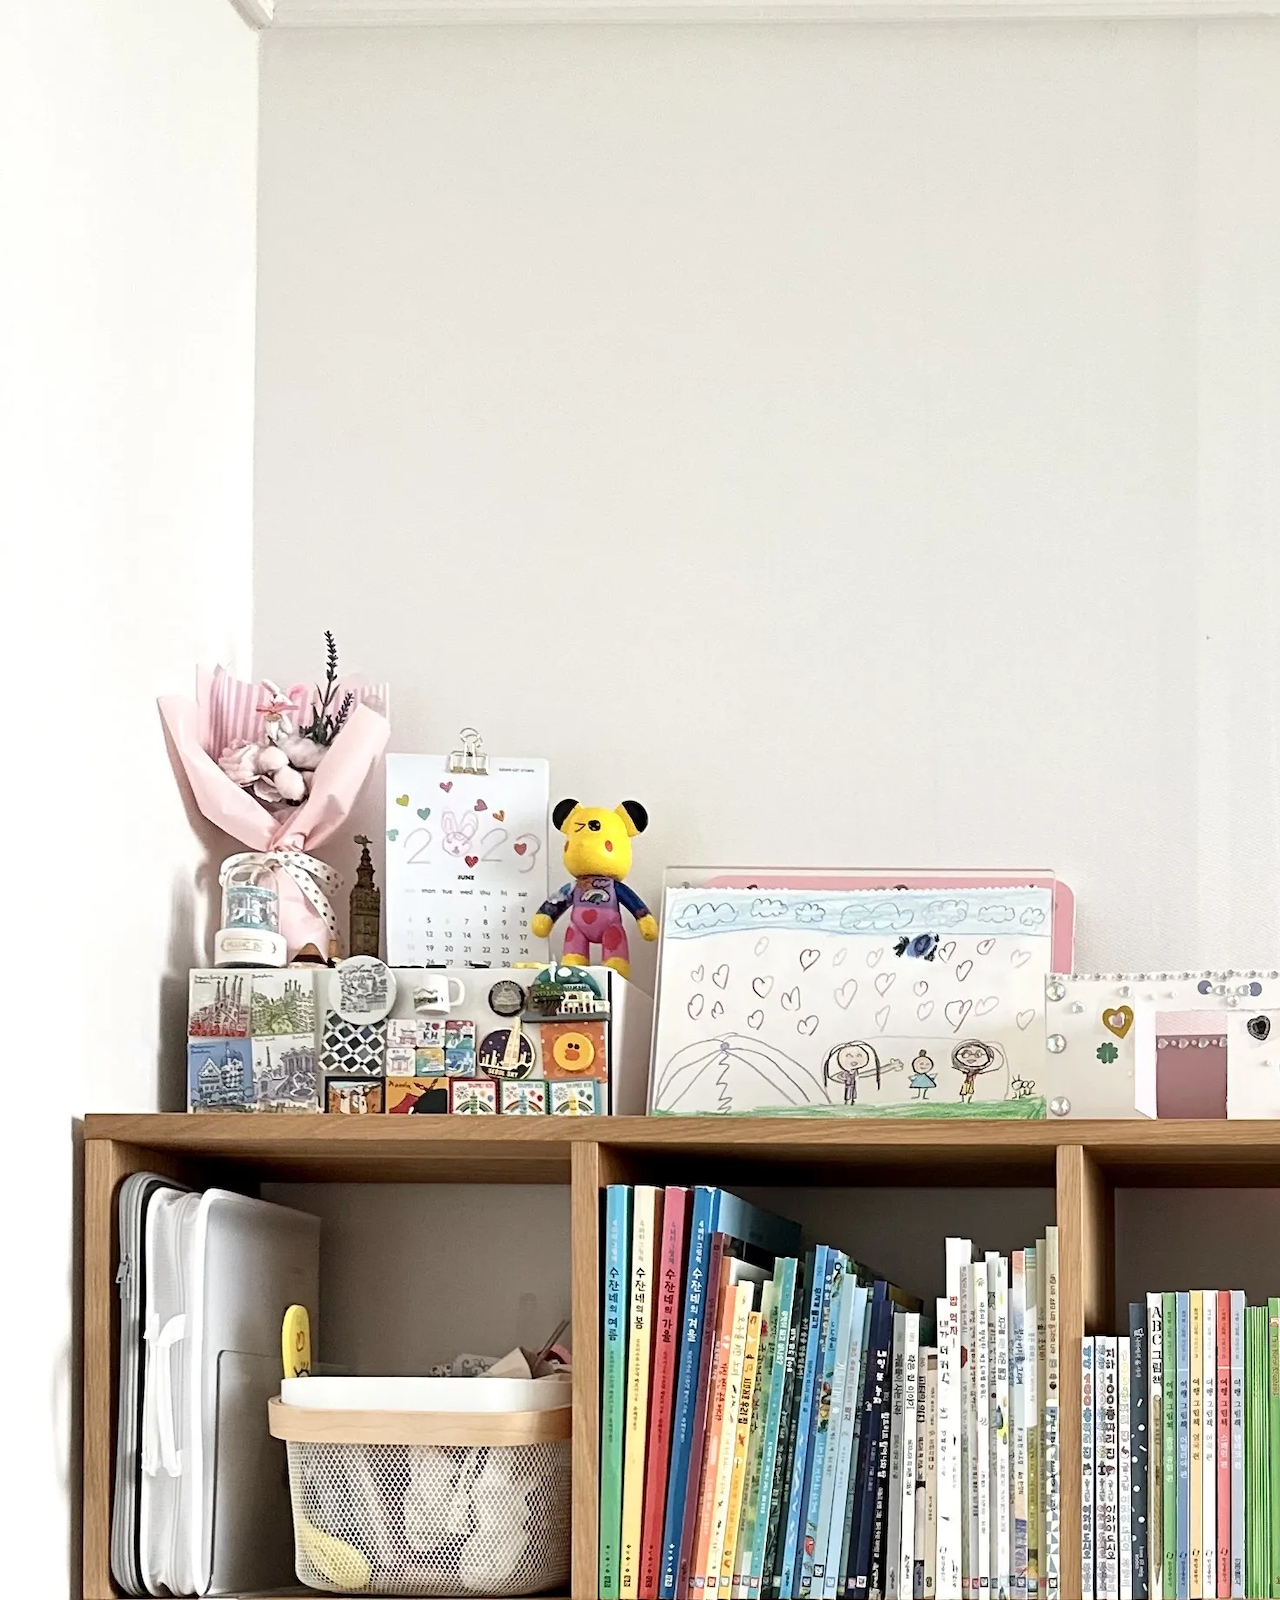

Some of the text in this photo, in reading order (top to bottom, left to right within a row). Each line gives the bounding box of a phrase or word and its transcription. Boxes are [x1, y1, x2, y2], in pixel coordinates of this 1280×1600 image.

[488, 1068, 518, 1078] SEOUL SKY
[608, 1267, 620, 1313] 수잔네의
[635, 1267, 646, 1314] 수잔네의
[664, 1268, 676, 1314] 수잔네의
[687, 1267, 703, 1342] 수잔네의 겨울
[608, 1317, 618, 1341] 여름
[634, 1318, 645, 1330] 봄
[662, 1319, 673, 1342] 가을
[998, 1316, 1006, 1334] 지구를
[940, 1320, 949, 1355] 내가 더
[1152, 1307, 1162, 1384] ABC 그림책
[998, 1351, 1007, 1365] 작은
[894, 1383, 903, 1399] 사는
[906, 1385, 915, 1410] 이야기
[917, 1375, 926, 1423] 피터의 의자
[1106, 1348, 1115, 1459] 지하 100층짜리 집
[893, 1400, 902, 1415] 나라
